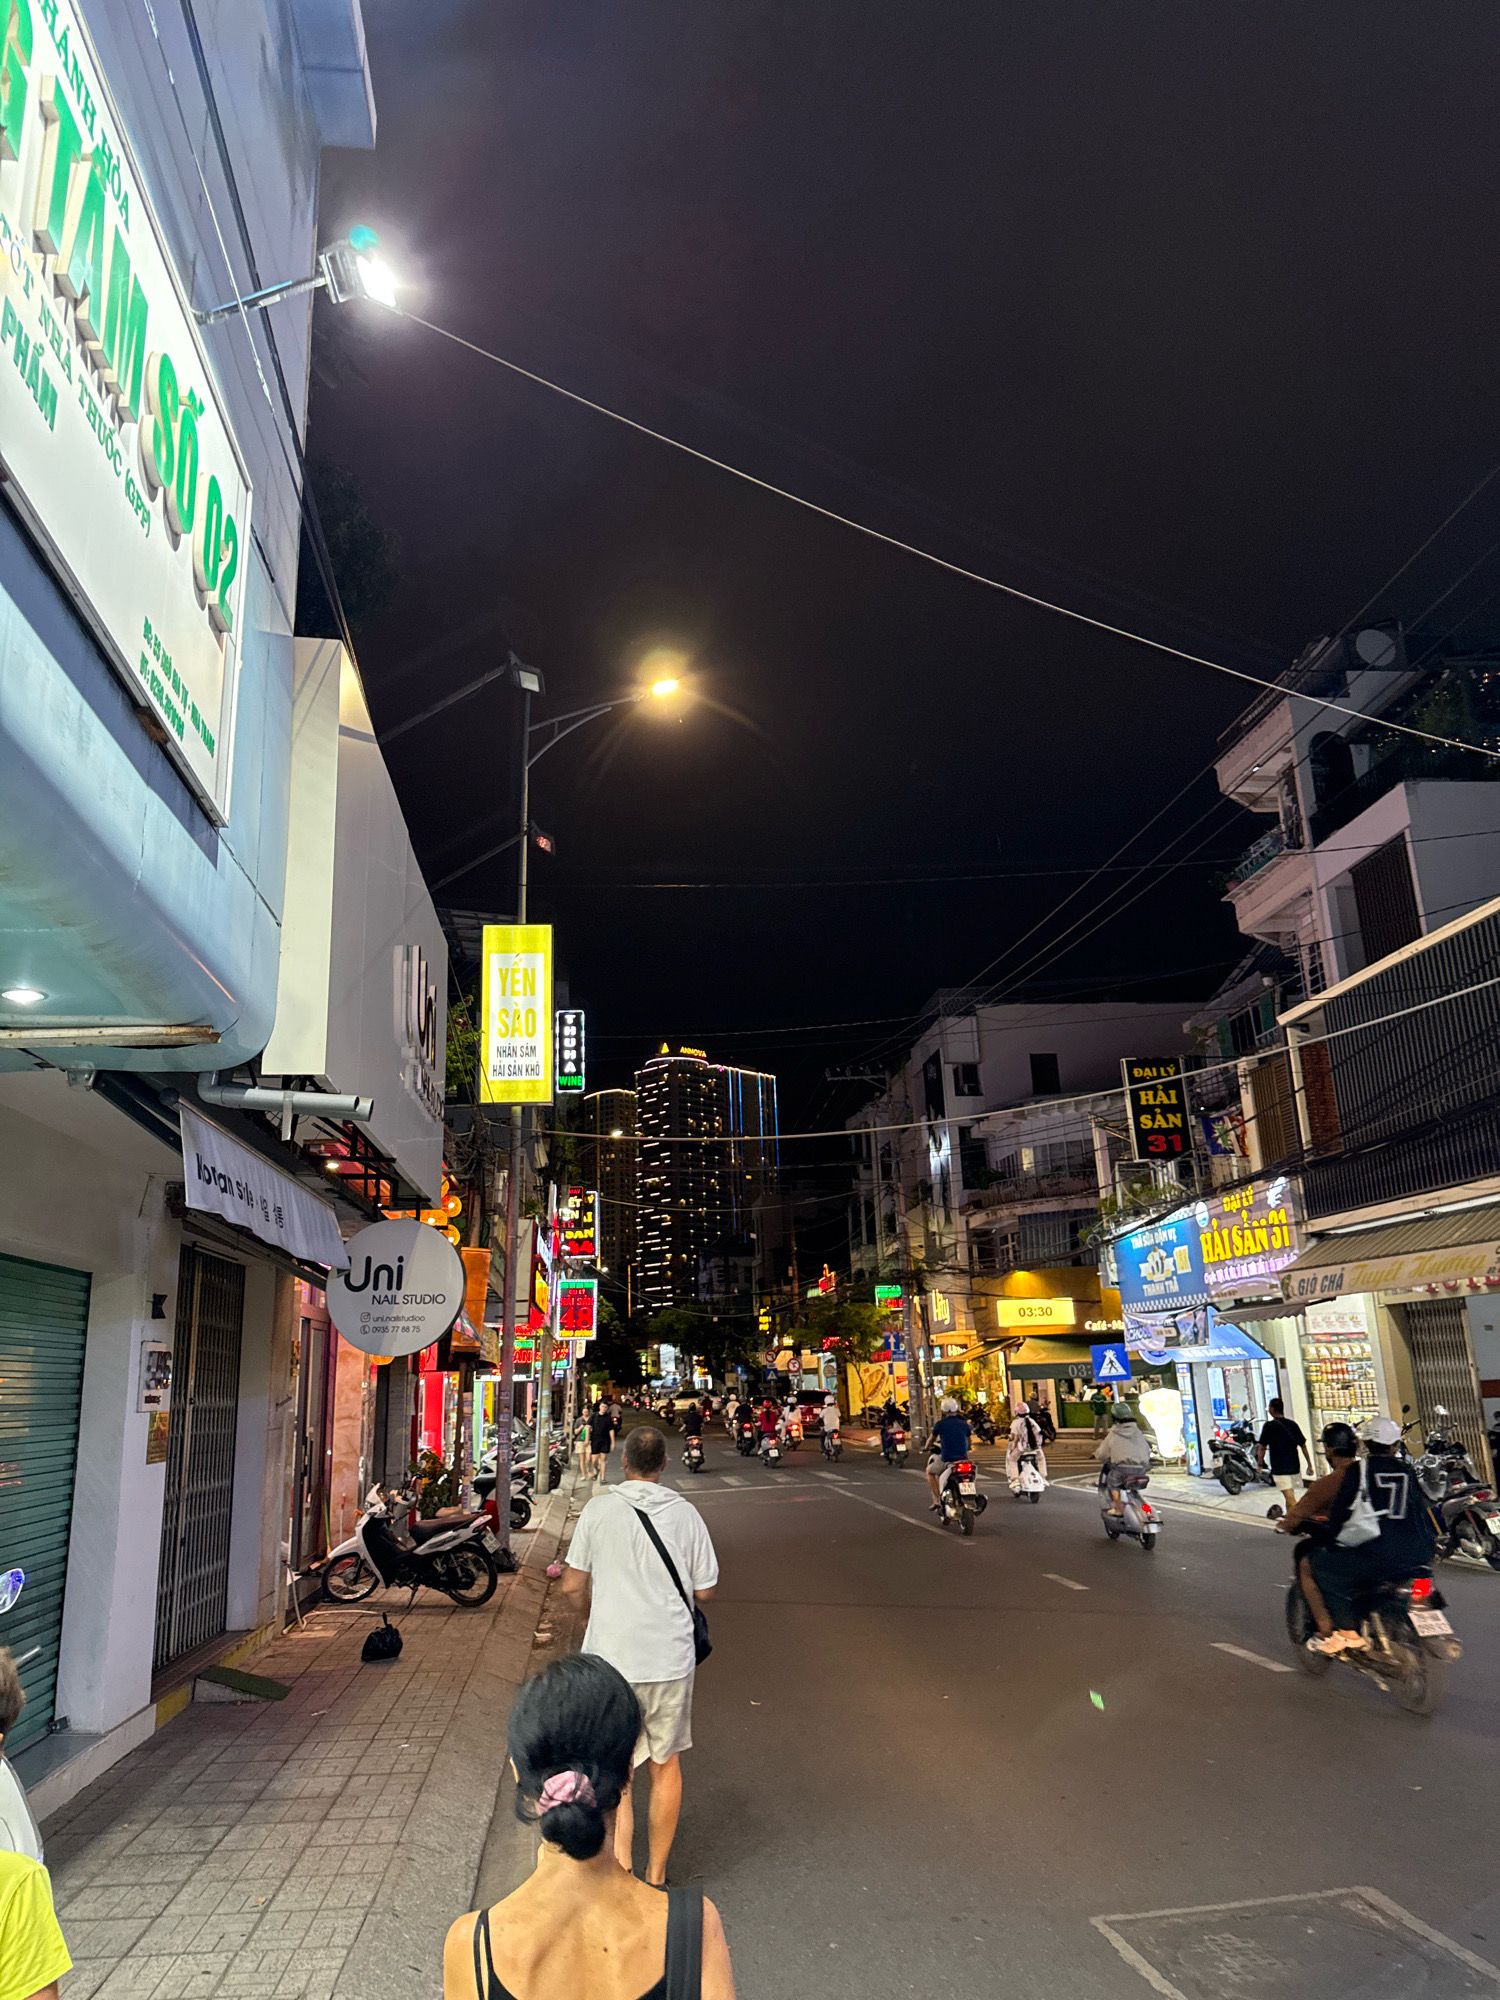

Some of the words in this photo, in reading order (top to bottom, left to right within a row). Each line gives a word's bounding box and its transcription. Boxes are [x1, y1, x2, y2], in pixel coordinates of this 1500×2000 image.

[37, 0, 97, 143] HÁNH
[38, 295, 73, 385] NHÀ
[78, 375, 123, 477] THUỐC
[124, 469, 151, 538] (GPP)
[141, 351, 205, 534] SỐ
[194, 473, 238, 633] 02
[498, 958, 536, 997] YẾN
[496, 1043, 517, 1058] NHÂN
[519, 1042, 537, 1058] SÂM
[493, 1060, 506, 1077] HẢI
[507, 1060, 523, 1077] SẢN
[525, 1060, 541, 1077] KHÔ
[1132, 1067, 1157, 1079] ĐẠI
[1160, 1064, 1176, 1076] LÝ
[558, 1075, 583, 1087] WINE
[1139, 1084, 1178, 1105] HẢI
[1139, 1108, 1182, 1129] SẢN
[1147, 1134, 1182, 1152] 31
[1223, 1193, 1241, 1213] ĐẠI
[1242, 1185, 1254, 1207] LÝ
[1200, 1218, 1233, 1264] HẢI
[1232, 1210, 1269, 1257] SẢN
[1268, 1208, 1290, 1249] 31
[344, 1256, 404, 1292] Uni
[1298, 1272, 1318, 1296] GIÒ
[1320, 1267, 1344, 1293] CHẢ
[1348, 1260, 1404, 1287] Tuyết
[1408, 1254, 1487, 1278] Hương
[372, 1294, 400, 1305] NAIL
[402, 1293, 446, 1305] STUDIO
[560, 1307, 594, 1328] 48
[1018, 1306, 1053, 1318] 03:30
[372, 1326, 389, 1334] 0935
[391, 1326, 400, 1334] 77
[1069, 1364, 1092, 1378] 03:
[1375, 1472, 1408, 1519] 7
